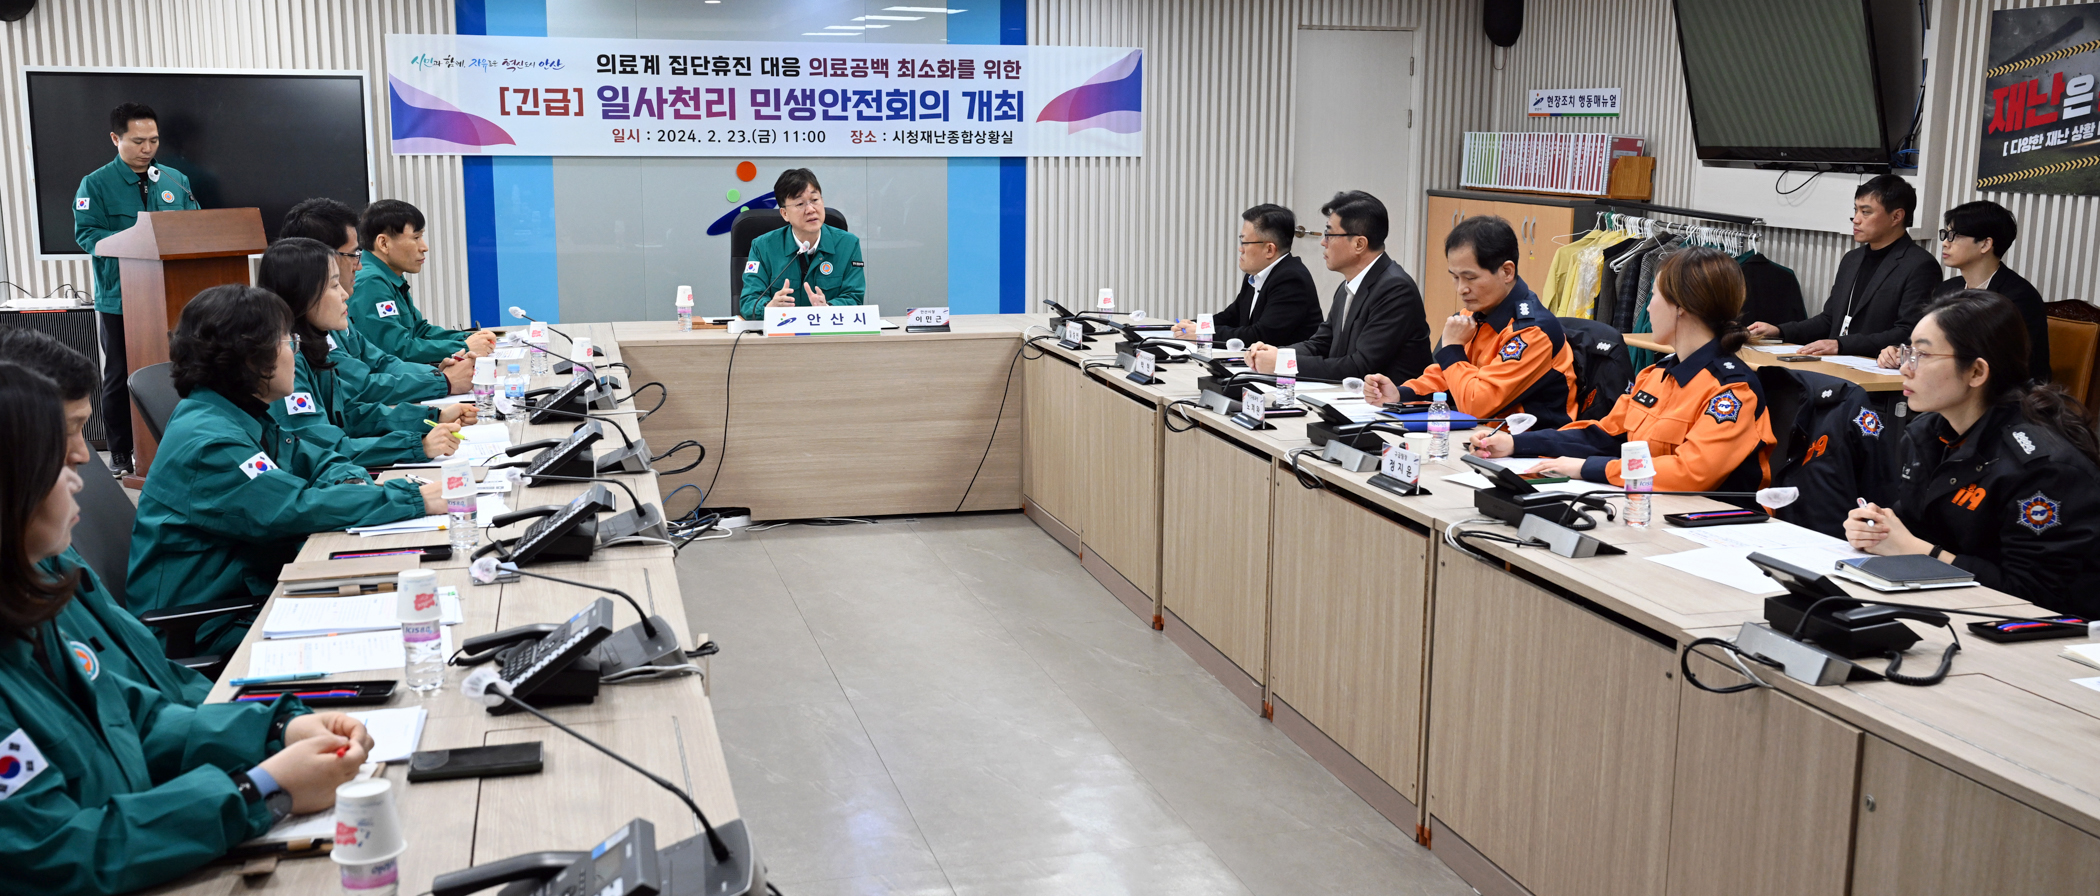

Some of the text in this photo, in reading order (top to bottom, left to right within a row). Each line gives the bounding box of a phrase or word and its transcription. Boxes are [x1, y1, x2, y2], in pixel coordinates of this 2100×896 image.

[411, 53, 442, 71] 시민과
[468, 58, 498, 73] 자유로운
[538, 58, 566, 71] 안산
[596, 54, 1022, 80] 의료계 집단휴진 대응 의료공백 최소화를 위한
[499, 85, 1024, 122] [긴급] 일사천리 민생안전회의 개최
[1547, 94, 1617, 108] 현장조치 행동매뉴얼
[1988, 71, 2095, 135] 재난은
[612, 128, 641, 143] 일시
[657, 129, 701, 143] 2024.
[707, 130, 721, 143] 2.
[727, 129, 777, 144] 23.(금)
[783, 130, 826, 143] 11:00
[850, 130, 878, 144] 장소
[892, 130, 1014, 144] 시청재난종합상황실
[2010, 133, 2045, 155] 다양한
[2045, 128, 2070, 147] 재난
[2071, 121, 2096, 141] 상황
